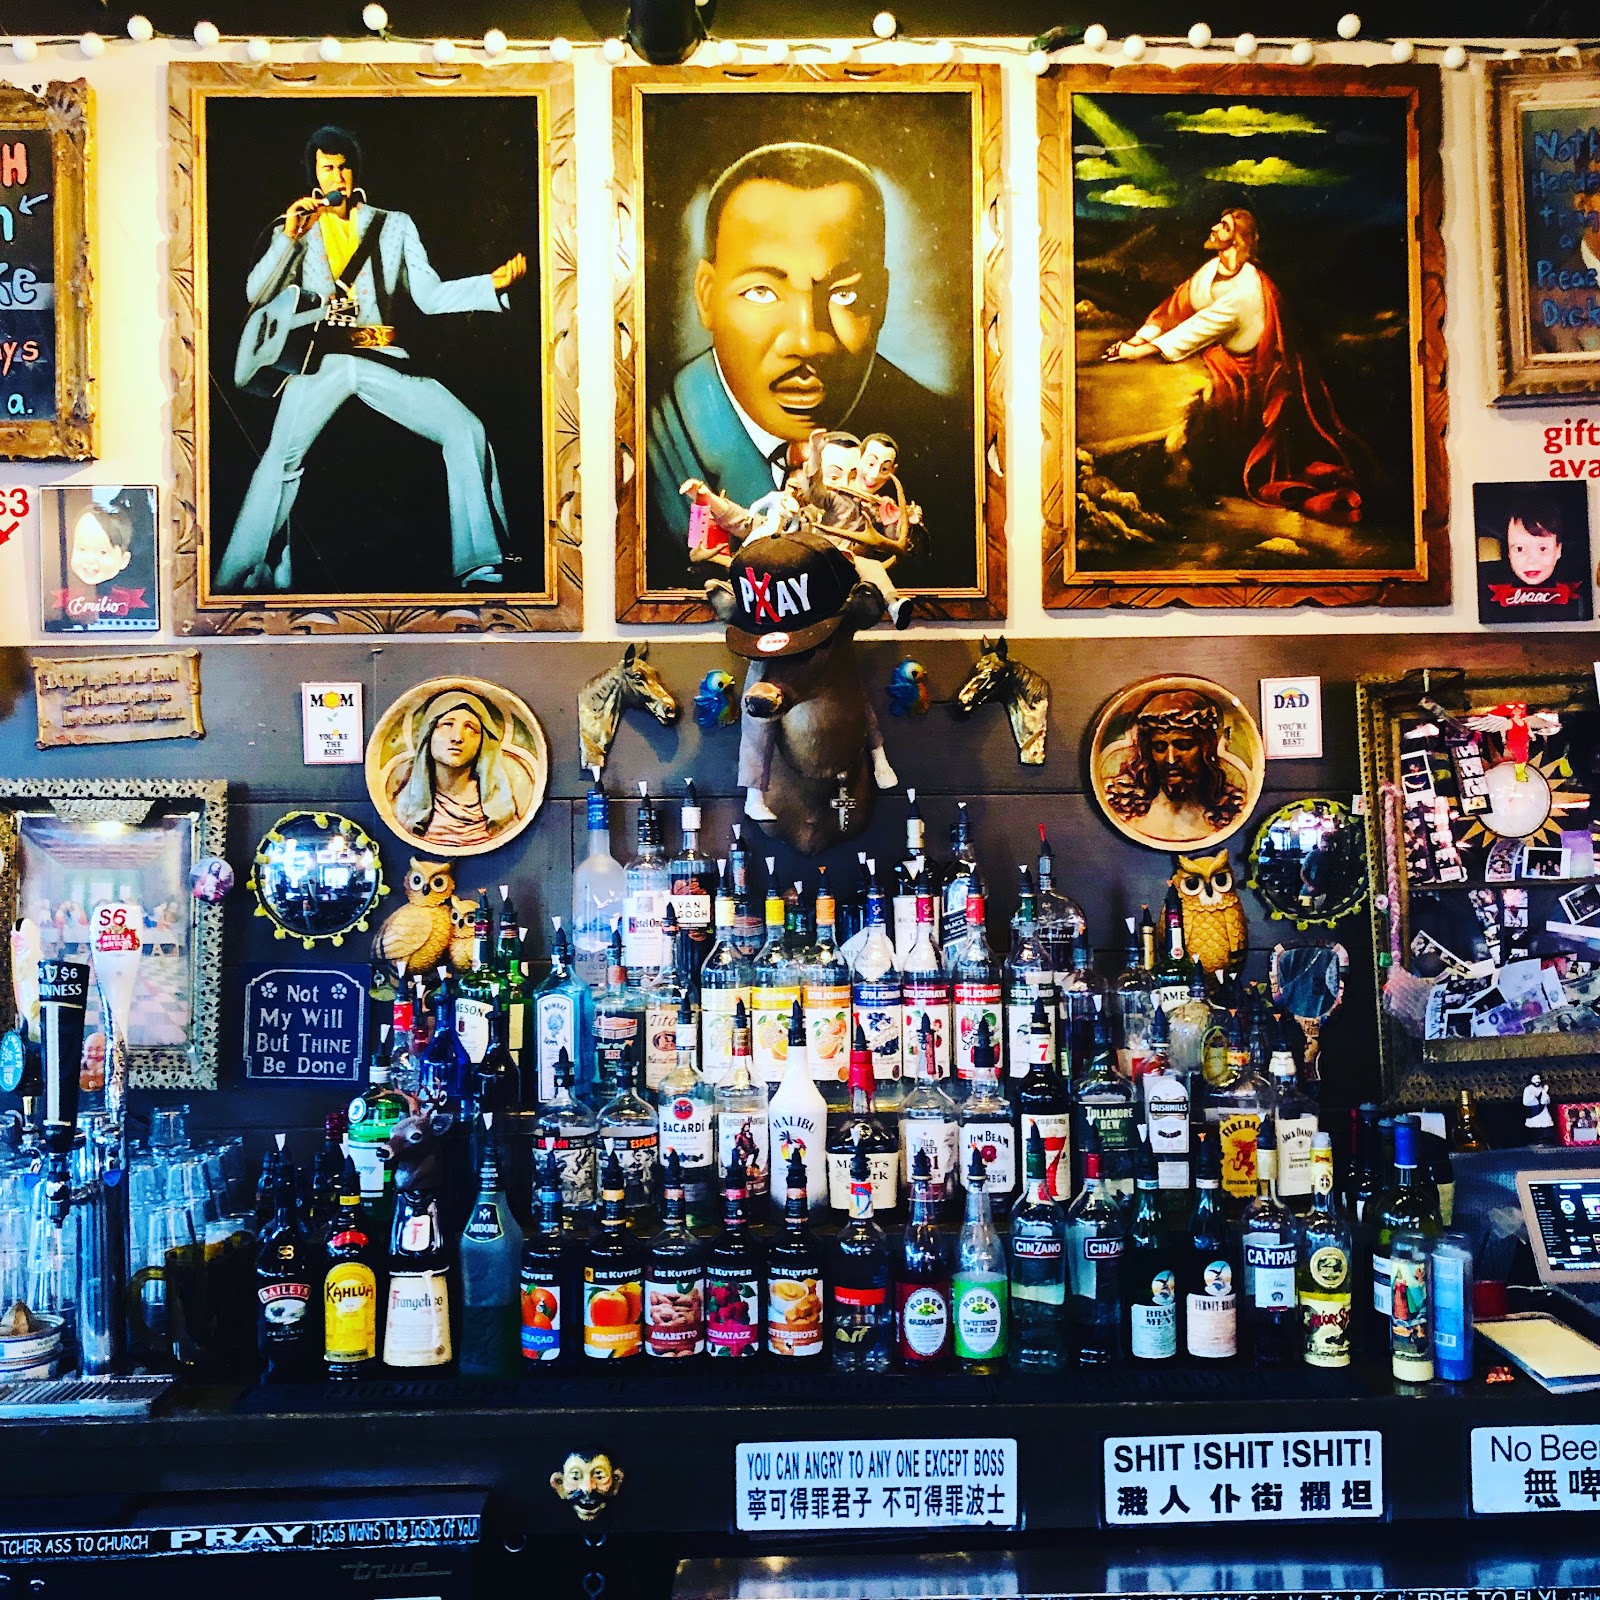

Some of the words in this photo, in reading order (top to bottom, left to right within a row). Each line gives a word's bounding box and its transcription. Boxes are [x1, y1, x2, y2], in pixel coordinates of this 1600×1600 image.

[1506, 589, 1561, 605] Isaac
[68, 595, 129, 616] Emilio
[1274, 694, 1310, 709] DAD
[678, 901, 701, 909] VAN
[677, 910, 708, 919] GOGH
[944, 919, 966, 931] BLACK
[61, 966, 78, 982] $6
[287, 985, 319, 1003] Not
[259, 1008, 292, 1031] My
[301, 1008, 343, 1028] Will
[256, 1032, 290, 1053] But
[299, 1033, 351, 1054] THINE
[1038, 1044, 1048, 1061] 7
[263, 1056, 286, 1073] Be
[297, 1057, 347, 1074] Done
[1085, 1106, 1133, 1119] TULLAMORE
[1151, 1103, 1188, 1112] BUSHMILLS
[663, 1120, 705, 1133] BACARDÍ
[773, 1116, 818, 1134] MALIBU
[1101, 1119, 1120, 1130] DEW
[968, 1134, 983, 1149] JIM
[985, 1130, 1009, 1148] BEAM
[836, 1159, 889, 1169] Maer's
[469, 1223, 498, 1233] MIDORI
[1016, 1241, 1061, 1255] CINZANO
[595, 1271, 607, 1279] DE
[654, 1270, 666, 1278] DE
[715, 1267, 752, 1277] KUYPER
[781, 1267, 818, 1278] KUYPER
[262, 1285, 309, 1300] BAILEYS
[326, 1281, 373, 1304] KAHLÚA
[909, 1297, 944, 1311] ROSE'S
[964, 1295, 997, 1309] ROSE'S
[651, 1330, 697, 1341] AMARETTO
[1491, 1435, 1531, 1462] No
[1541, 1434, 1600, 1461] Bee
[747, 1453, 771, 1481] YOU
[776, 1452, 800, 1480] CAN
[805, 1451, 844, 1479] ANGRY
[849, 1450, 864, 1478] TO
[868, 1450, 891, 1478] ANY
[897, 1450, 920, 1478] ONE
[925, 1449, 969, 1477] EXCEPT
[974, 1449, 1005, 1476] BOSS
[1114, 1443, 1185, 1473] SHIT
[747, 1487, 872, 1521] 寧可得罪君子
[882, 1484, 1005, 1518] 不可得罪波士
[45, 1538, 71, 1554] ASS
[76, 1537, 95, 1553] TO
[97, 1535, 149, 1552] CHURCH
[170, 1526, 305, 1549] PRAY
